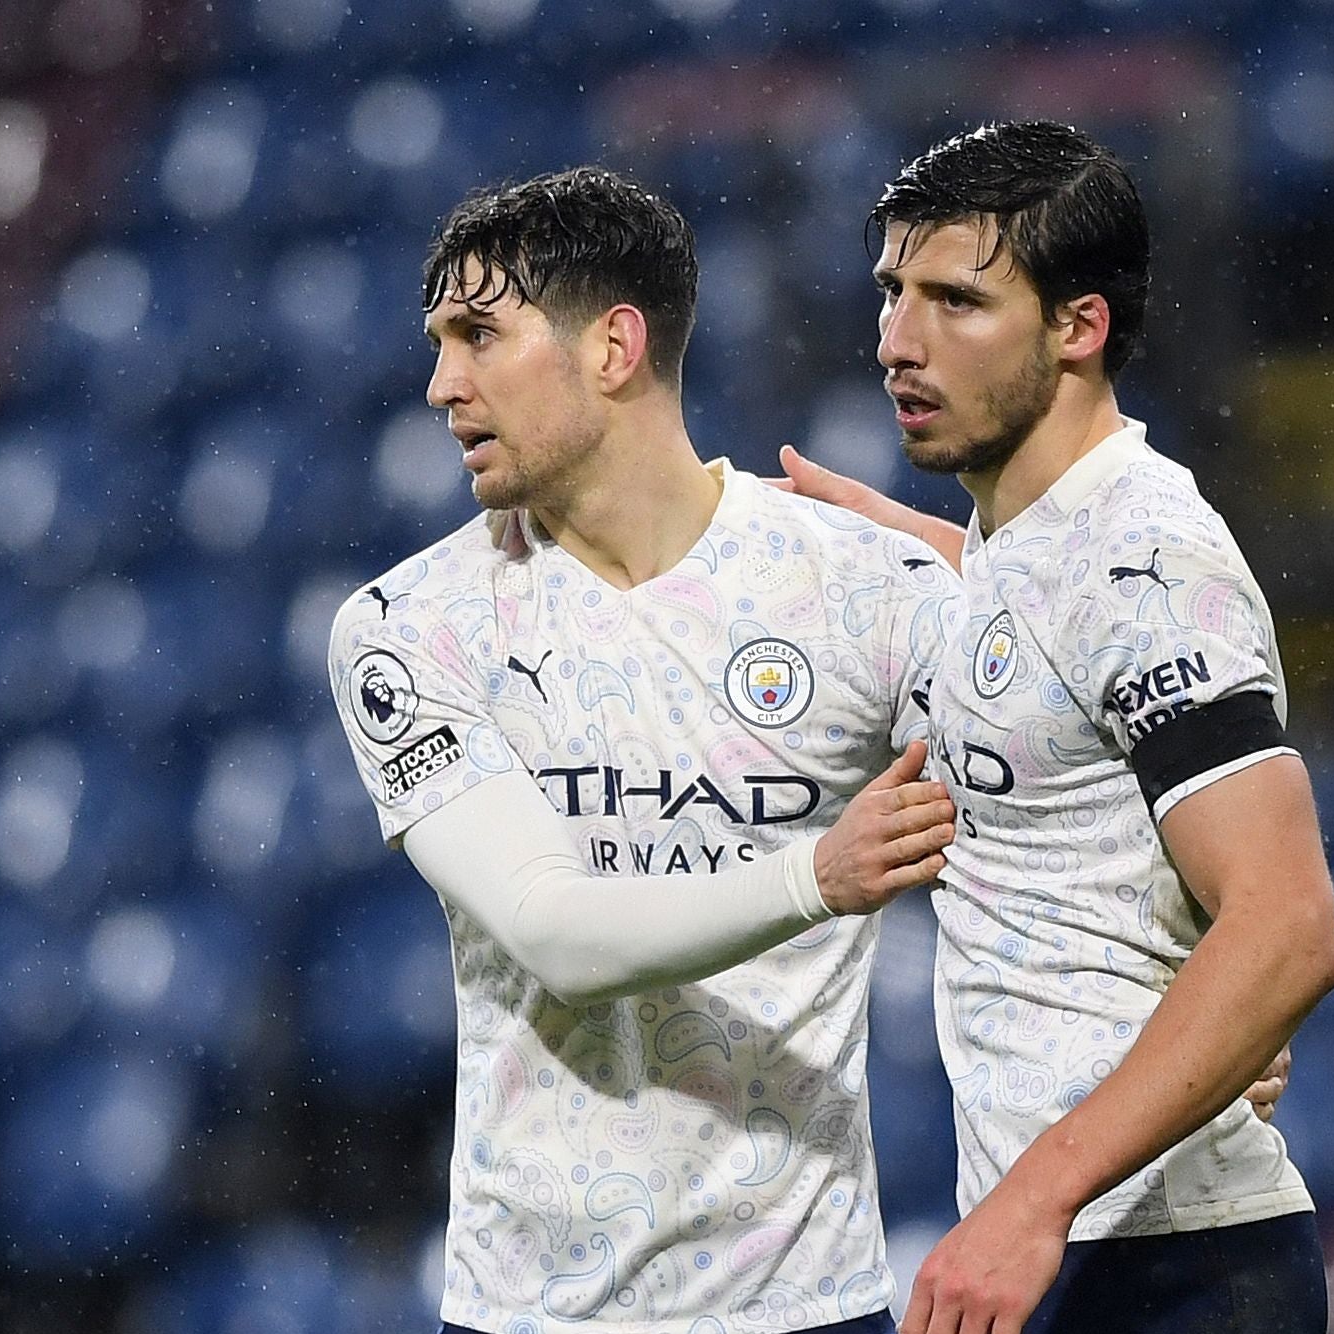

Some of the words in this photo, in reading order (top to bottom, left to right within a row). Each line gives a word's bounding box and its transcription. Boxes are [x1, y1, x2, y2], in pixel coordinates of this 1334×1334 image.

[735, 645, 804, 672] MANCHESTER
[980, 682, 994, 693] CITY
[1105, 651, 1211, 720] EXEN
[757, 713, 783, 722] CITY
[380, 762, 399, 784] No
[399, 734, 449, 773] room
[403, 743, 463, 788] racism
[529, 765, 821, 826] TIHAD
